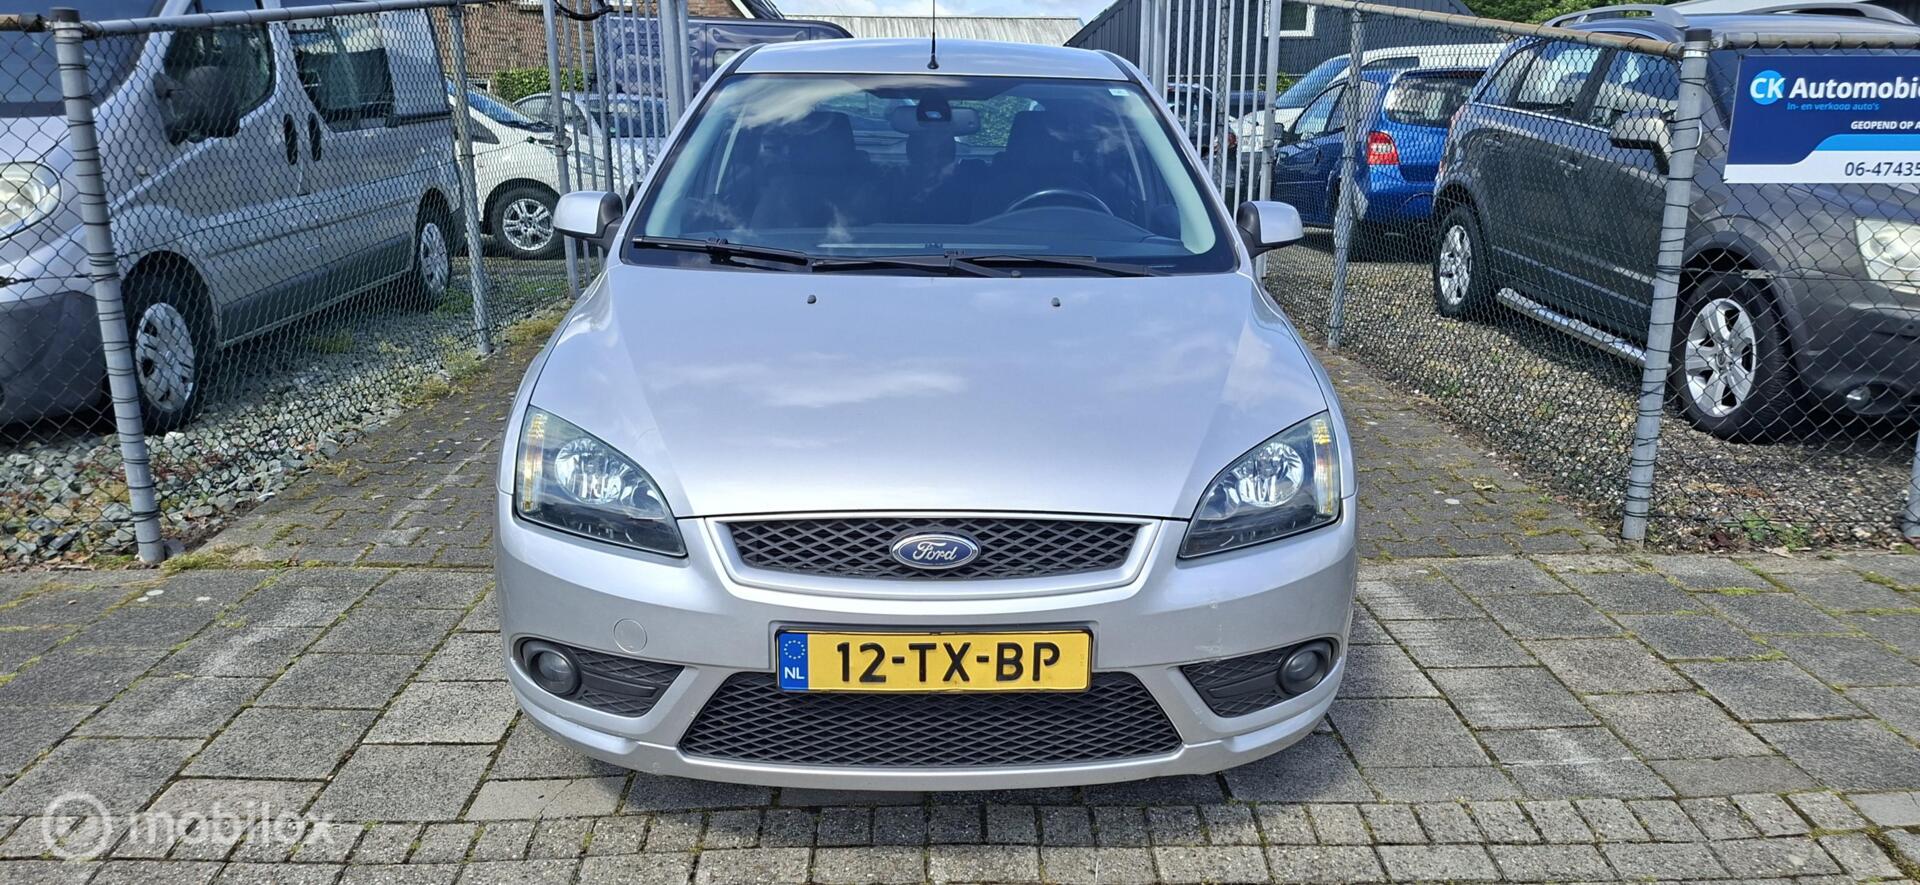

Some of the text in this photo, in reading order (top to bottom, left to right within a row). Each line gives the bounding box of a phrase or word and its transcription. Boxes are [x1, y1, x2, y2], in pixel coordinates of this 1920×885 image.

[1750, 77, 1786, 99] CK
[1801, 103, 1813, 111] en
[1852, 102, 1880, 111] auto's
[1850, 120, 1898, 130] GEOPEND
[1899, 120, 1914, 130] OP
[1844, 161, 1920, 177] 06-47435
[912, 541, 958, 561] Ford
[783, 666, 805, 680] NL
[836, 641, 1061, 683] 12-TX-BP
